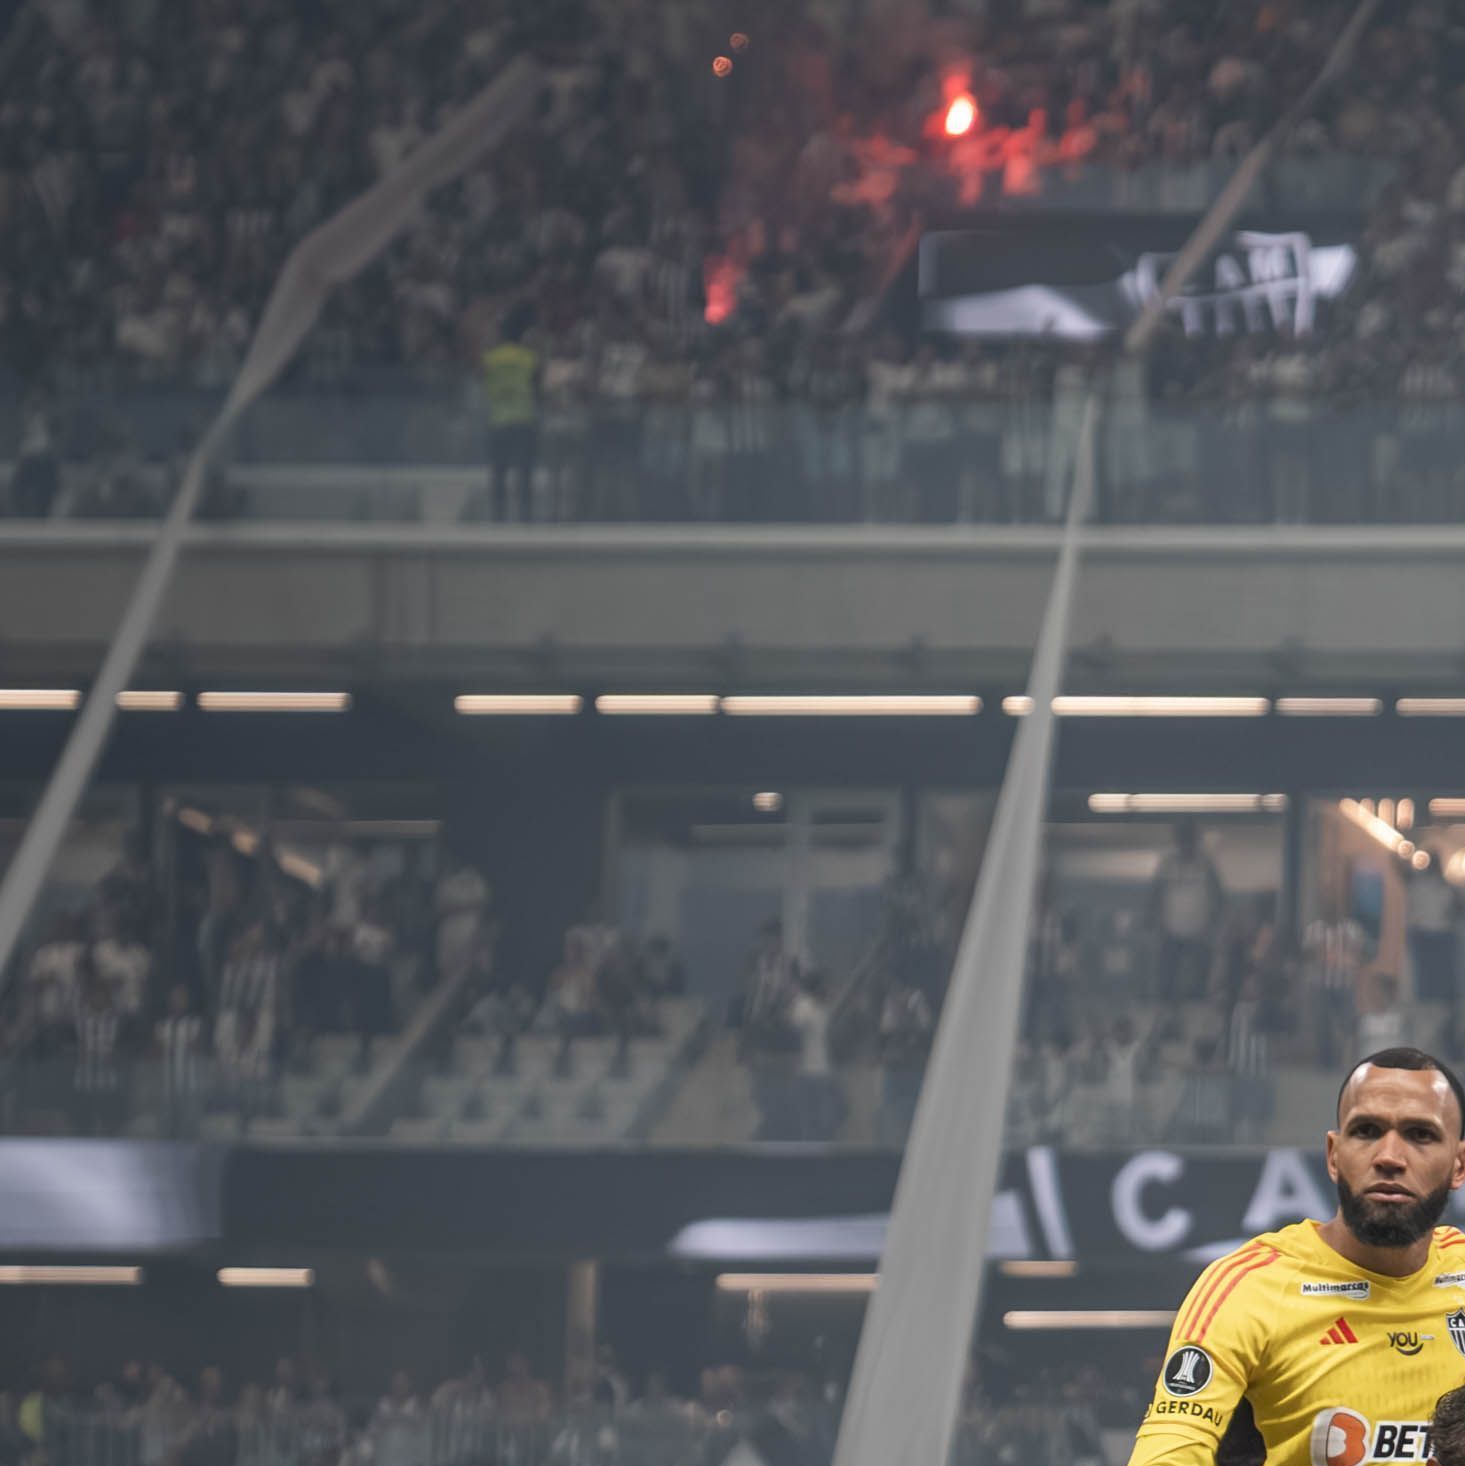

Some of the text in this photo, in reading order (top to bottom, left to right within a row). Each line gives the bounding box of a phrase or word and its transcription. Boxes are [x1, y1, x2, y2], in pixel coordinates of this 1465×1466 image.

[1303, 1280, 1369, 1293] Multimarcas
[1387, 1332, 1418, 1347] YOU
[1156, 1401, 1223, 1426] GERDAU
[1374, 1421, 1434, 1460] BET
